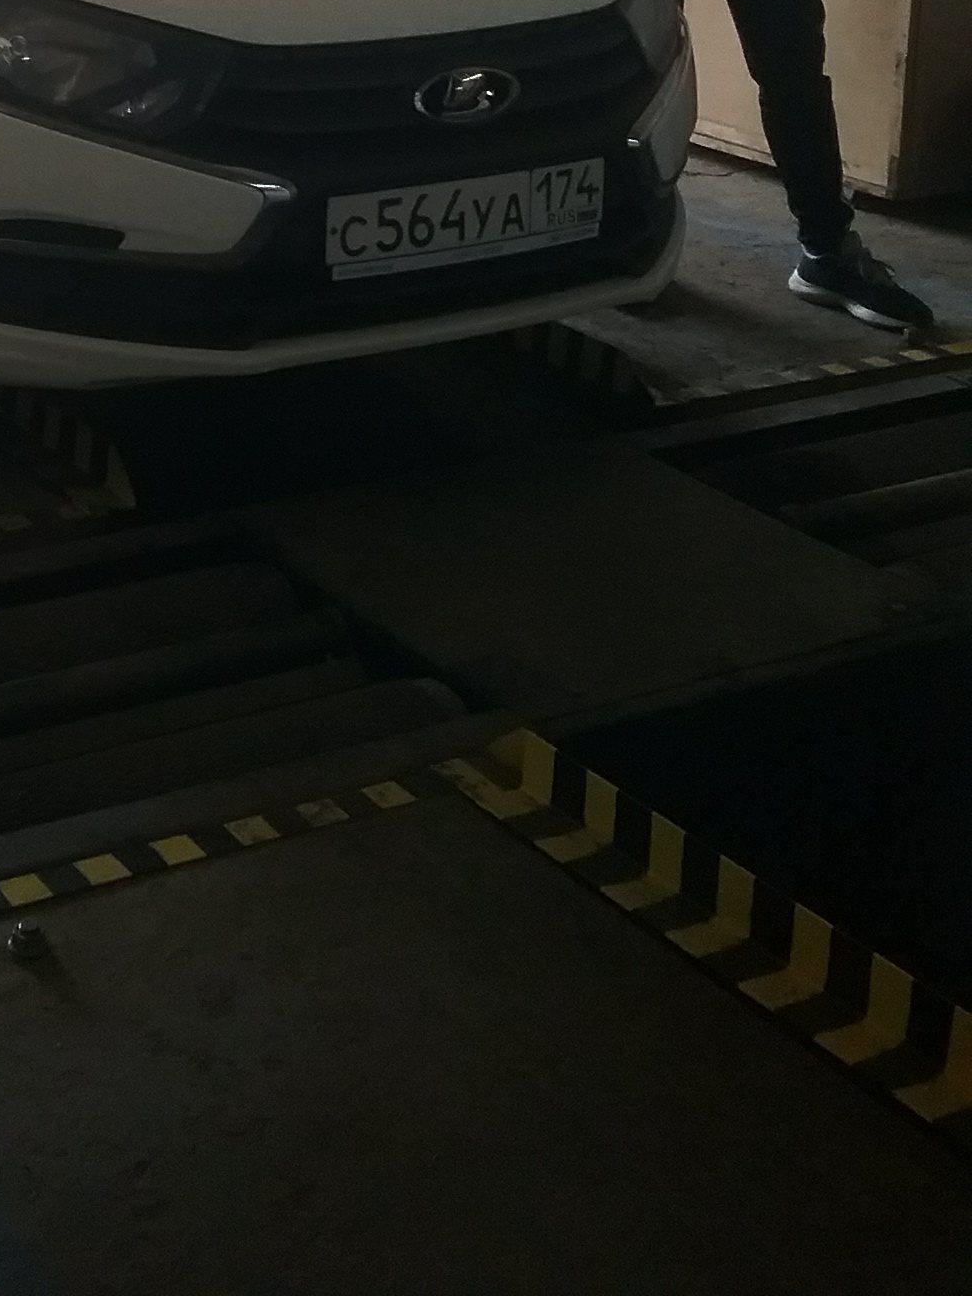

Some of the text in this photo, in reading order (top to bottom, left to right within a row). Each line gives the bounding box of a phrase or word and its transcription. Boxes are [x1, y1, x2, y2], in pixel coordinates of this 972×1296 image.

[339, 165, 599, 257] С564УА 174
[546, 209, 578, 226] RUS
